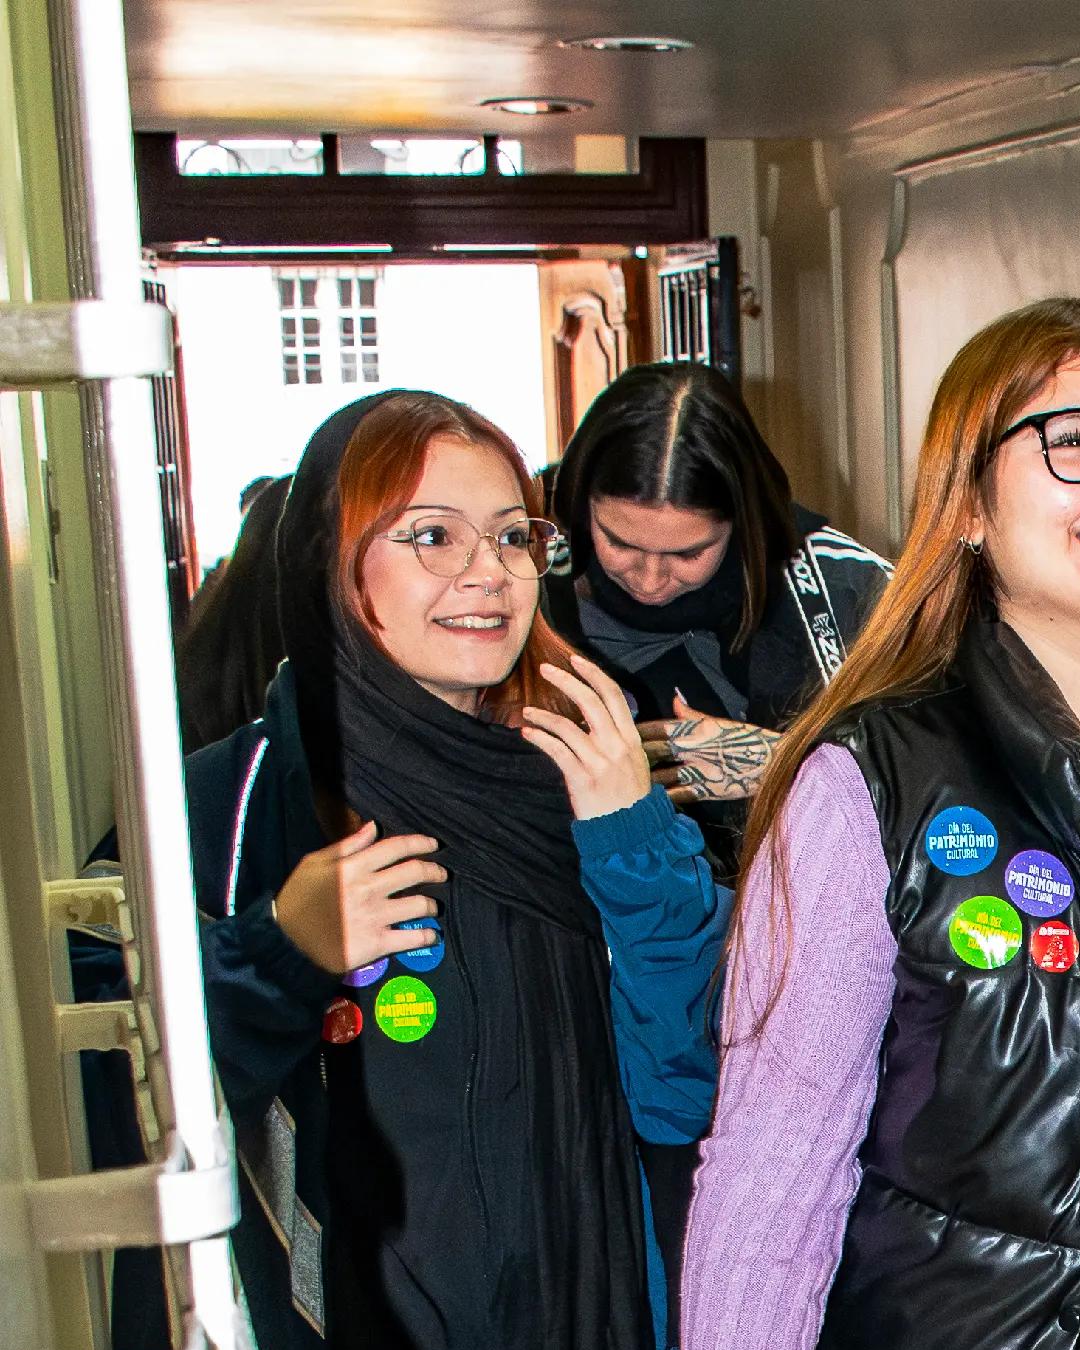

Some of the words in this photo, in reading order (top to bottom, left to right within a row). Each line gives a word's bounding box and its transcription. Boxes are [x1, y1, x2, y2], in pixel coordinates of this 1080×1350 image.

[961, 823, 975, 834] DEL
[928, 834, 995, 850] PATRIMONIO
[946, 848, 979, 860] CULTURAL
[1007, 870, 1071, 897] PATRIMONIO
[1022, 887, 1054, 905] CULTURAL
